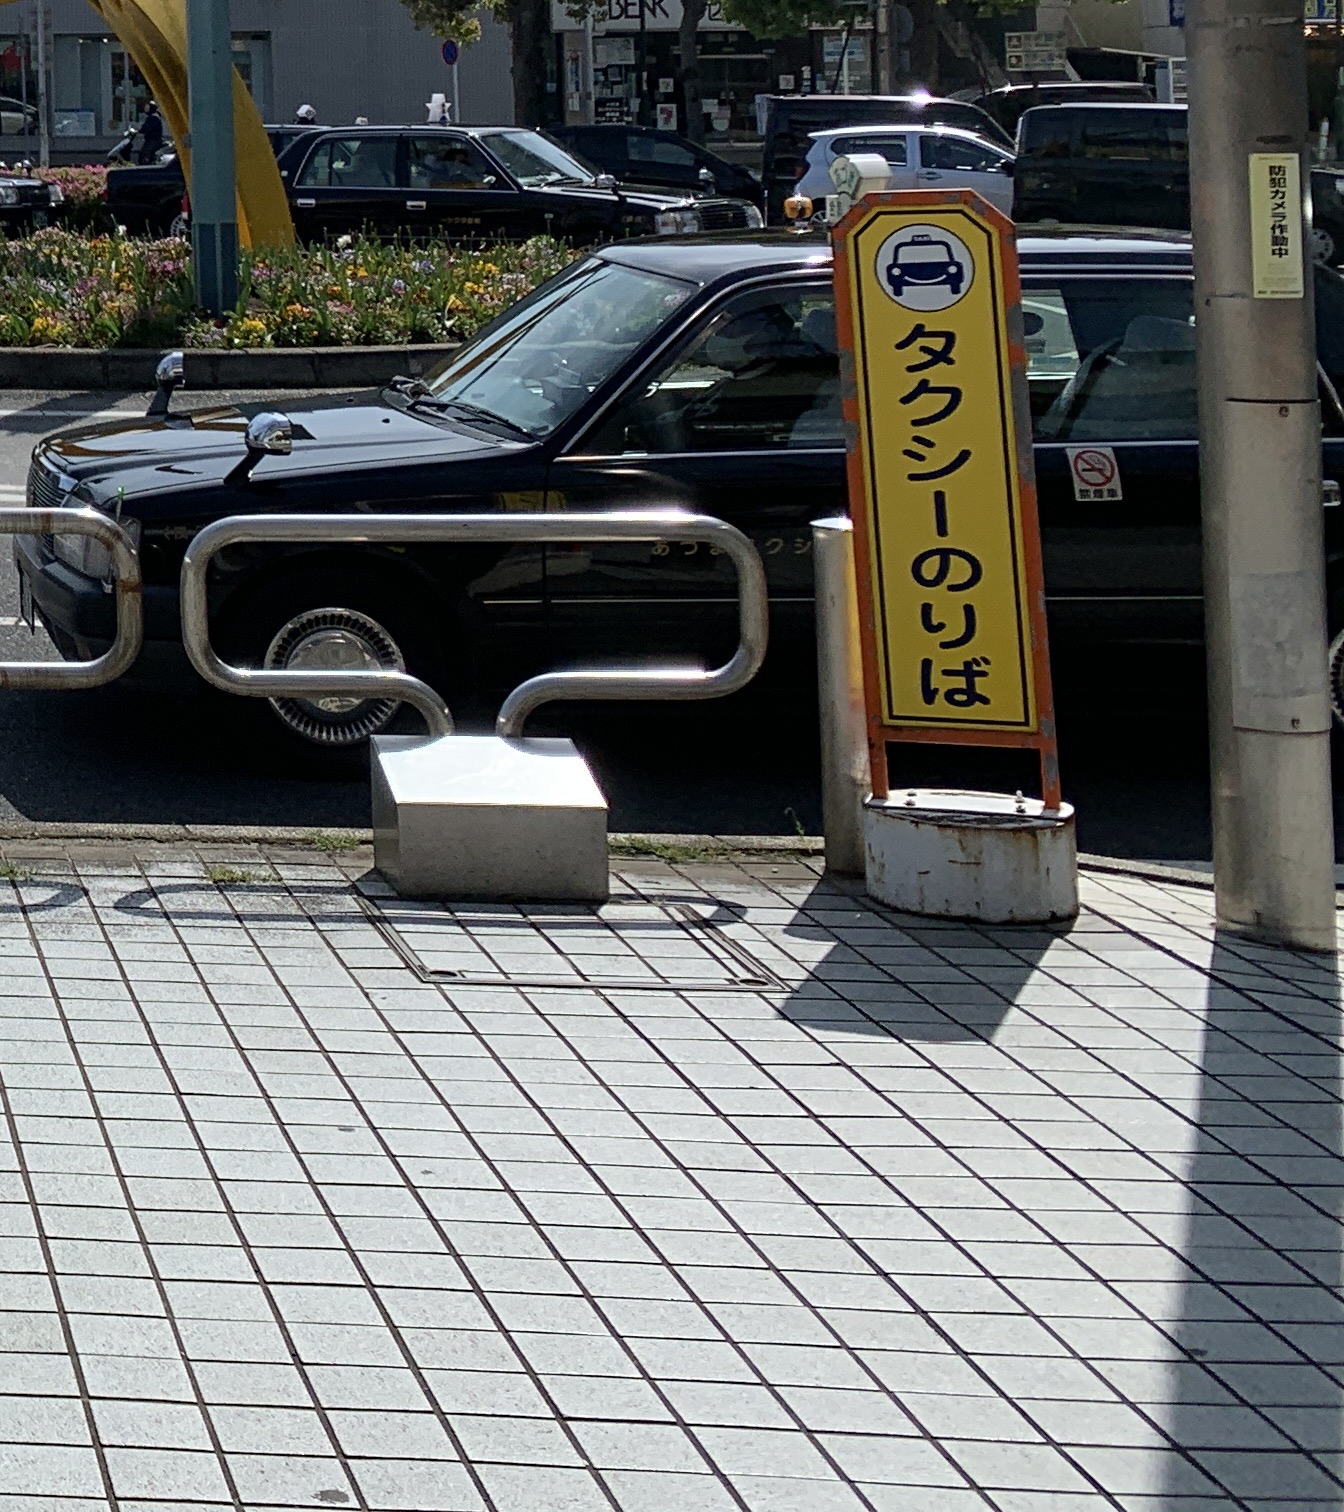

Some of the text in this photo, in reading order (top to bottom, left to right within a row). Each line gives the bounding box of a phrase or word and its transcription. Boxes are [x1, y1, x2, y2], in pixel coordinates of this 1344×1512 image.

[1268, 165, 1289, 258] 防犯カメラ作動中
[894, 322, 992, 708] タクシーのりば
